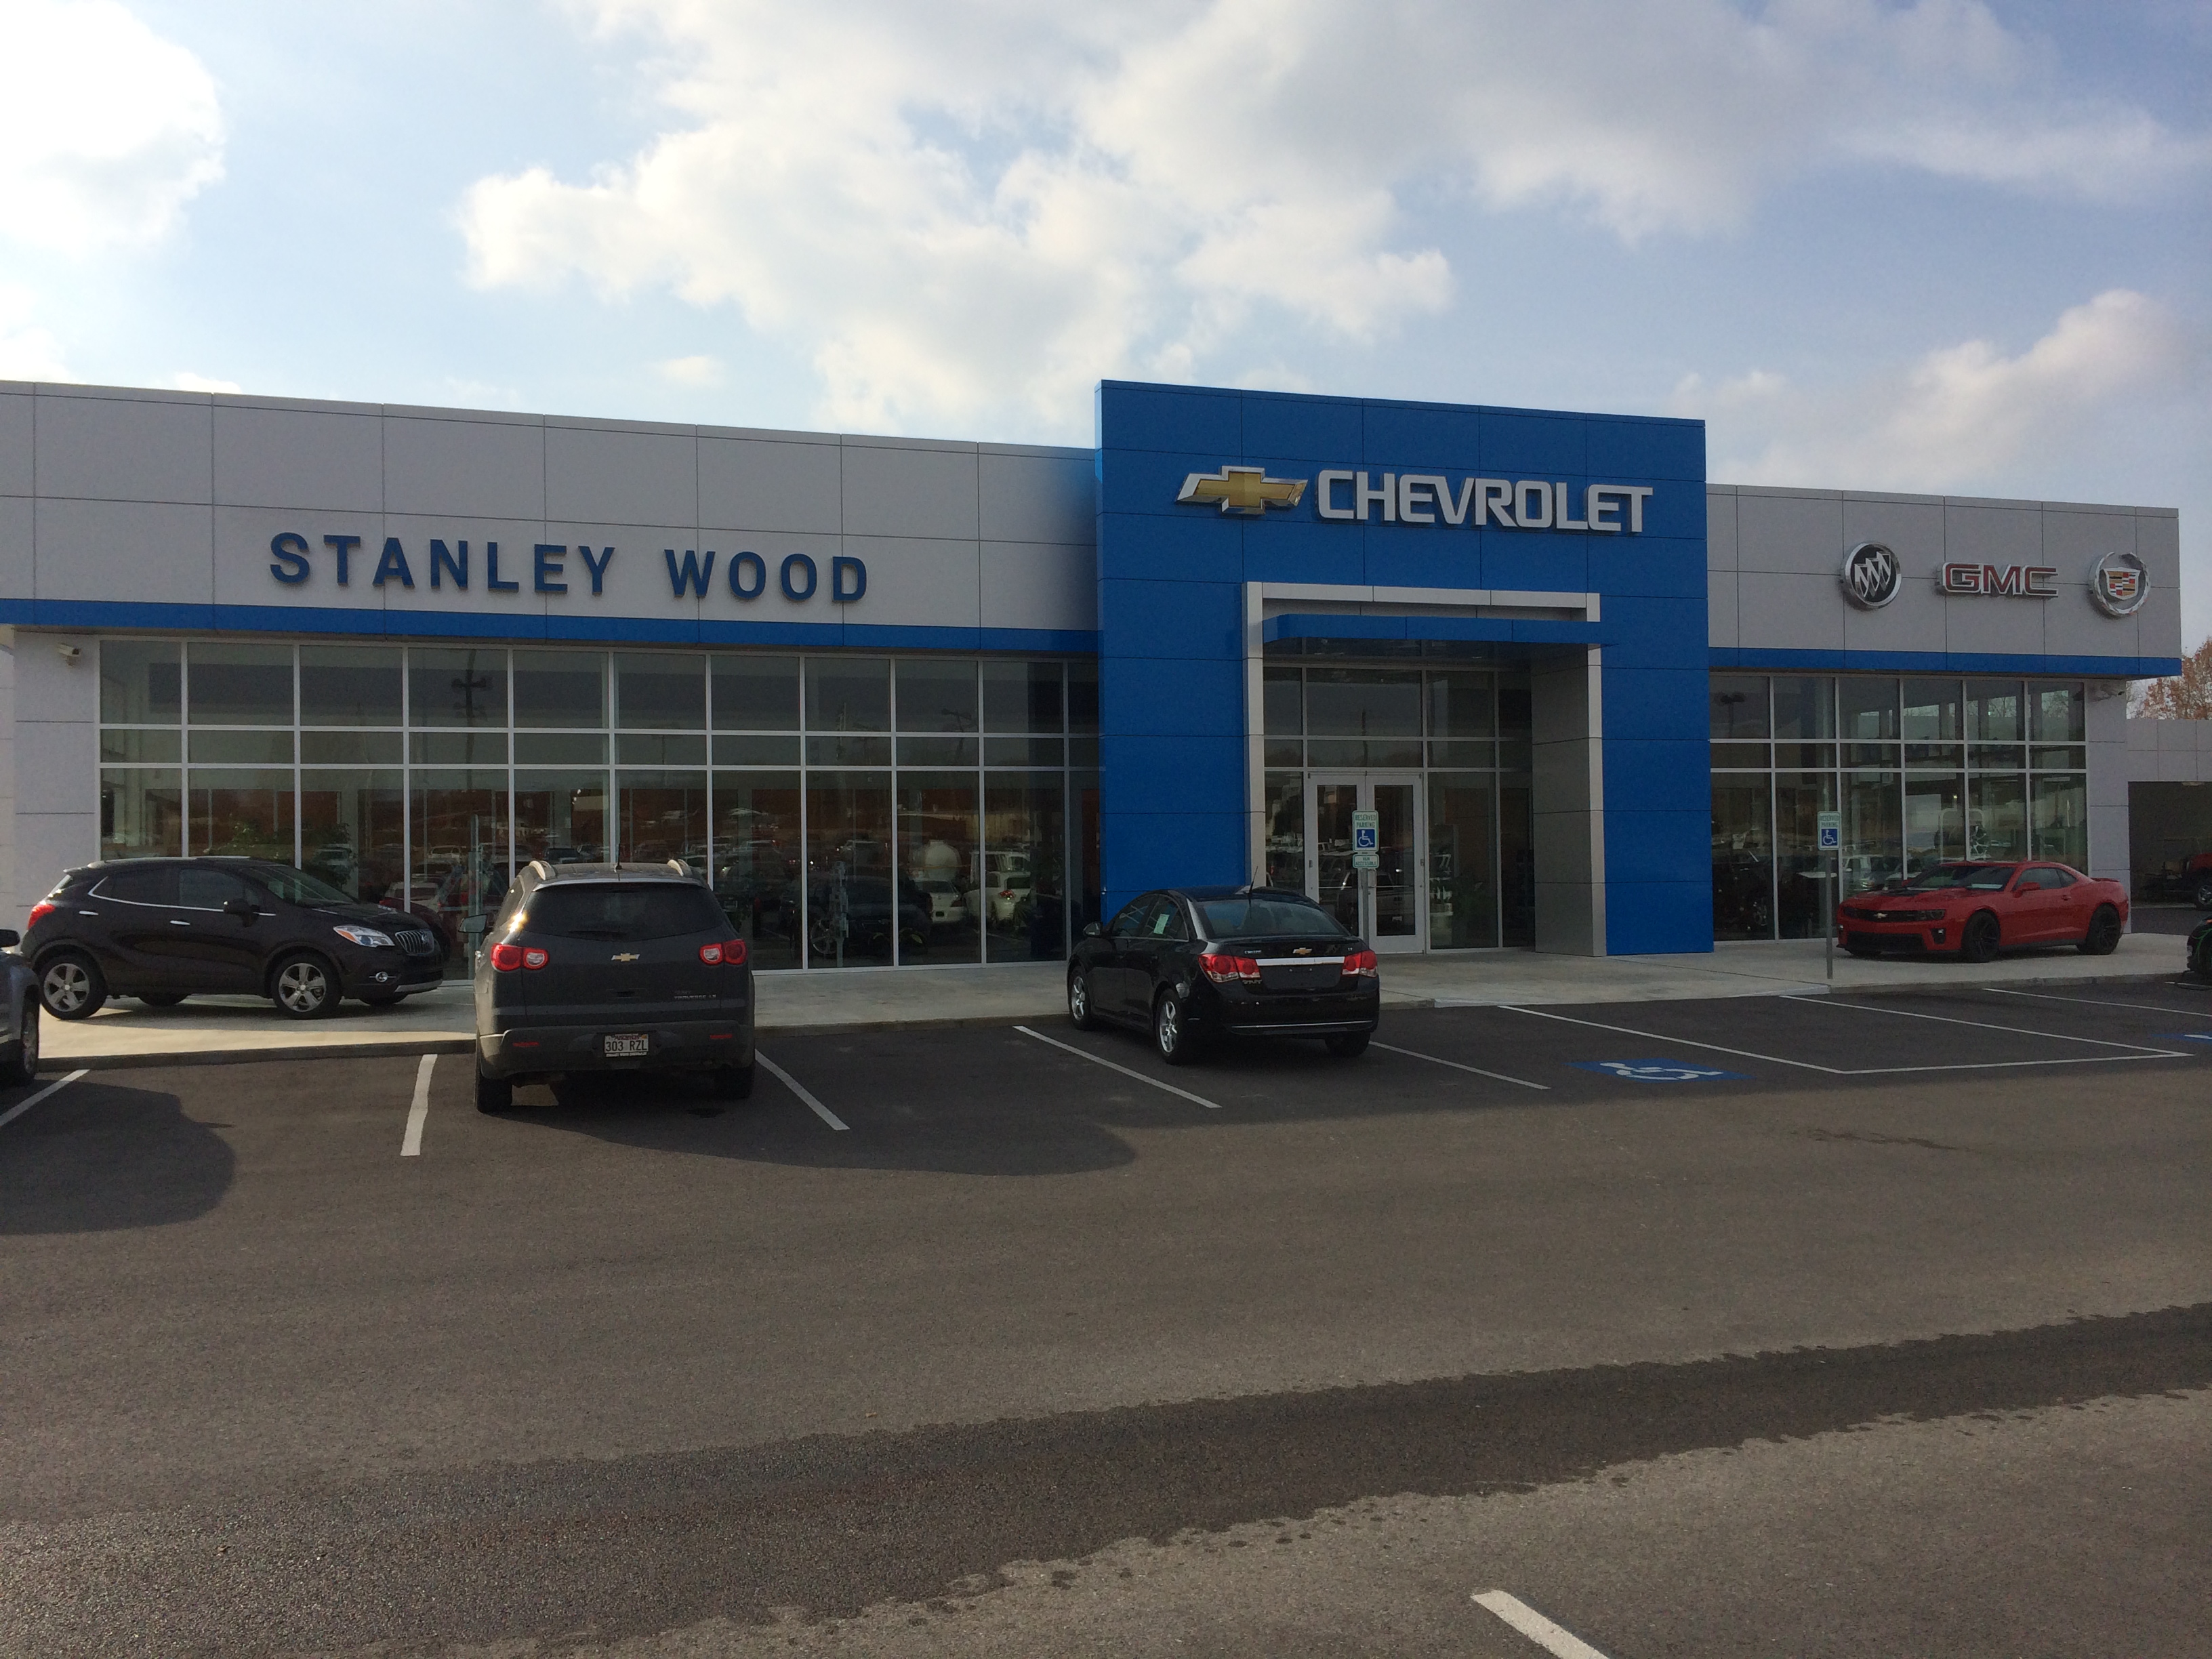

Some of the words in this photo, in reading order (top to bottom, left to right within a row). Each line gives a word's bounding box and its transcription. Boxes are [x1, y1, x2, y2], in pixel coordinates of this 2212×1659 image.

[1317, 470, 1654, 532] CHEVROLET
[270, 532, 616, 596] STANLEY
[664, 550, 868, 602] WOOD
[1942, 562, 2059, 598] GMC
[605, 1041, 624, 1052] 303
[630, 1040, 647, 1051] RZL
